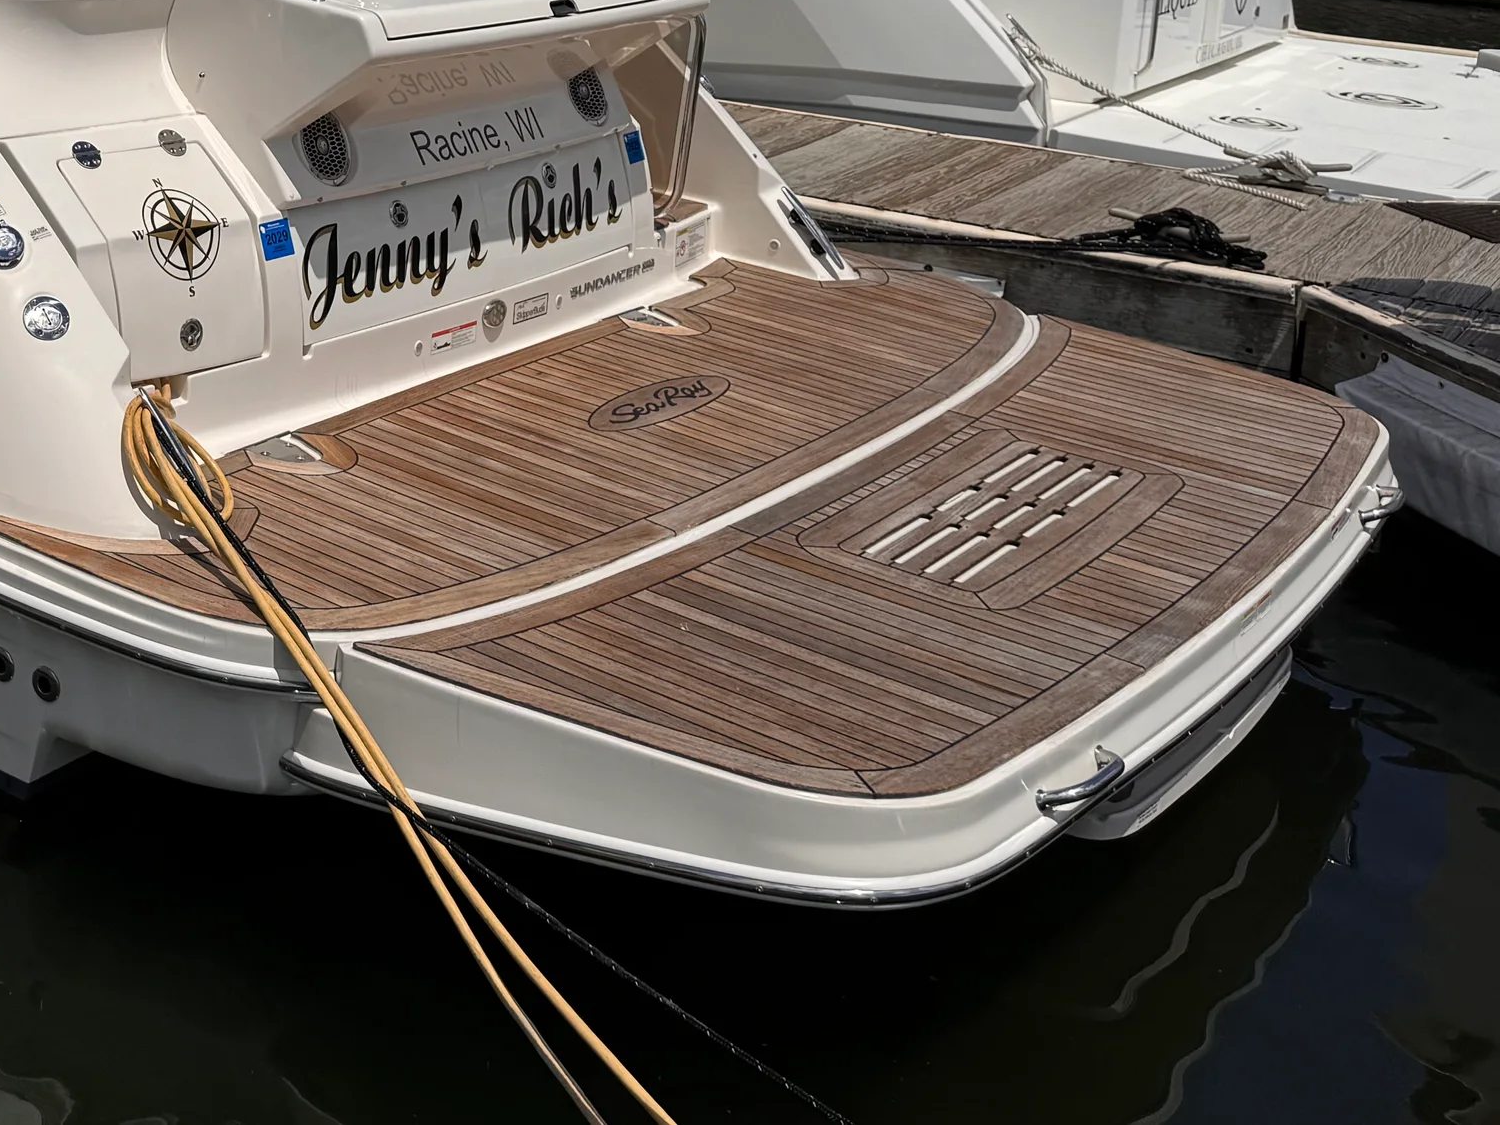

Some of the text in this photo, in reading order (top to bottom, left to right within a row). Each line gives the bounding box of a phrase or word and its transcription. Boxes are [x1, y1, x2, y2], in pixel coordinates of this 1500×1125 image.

[409, 106, 544, 166] Racine, WI
[152, 178, 163, 188] N
[220, 217, 229, 228] E
[132, 229, 145, 241] W
[265, 229, 289, 246] 2029
[301, 156, 624, 330] Jenny's Rich's
[570, 263, 641, 300] SUNDANCER
[188, 285, 196, 297] S
[609, 379, 713, 424] Sea Ray
